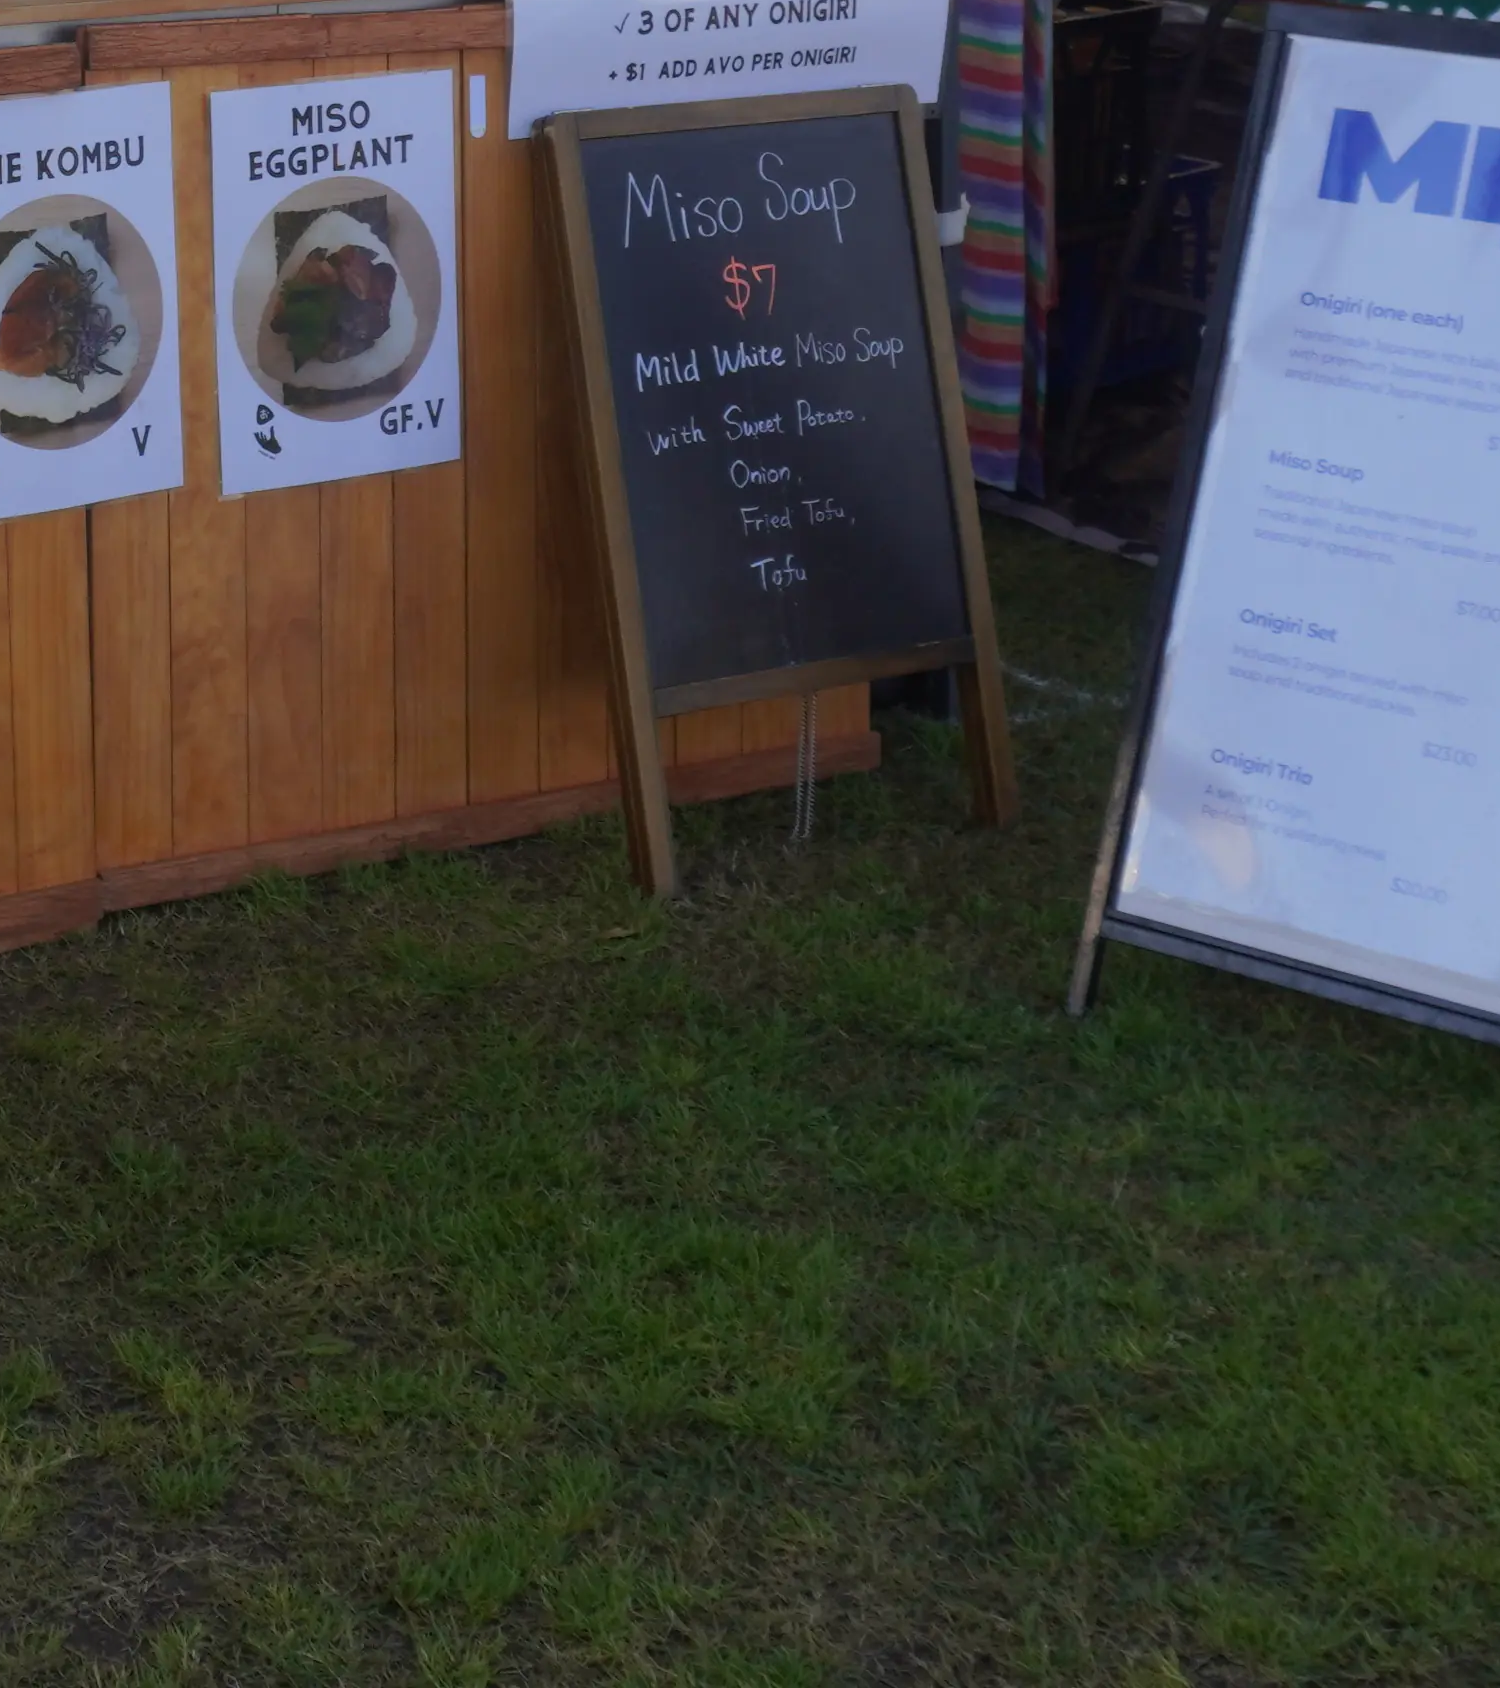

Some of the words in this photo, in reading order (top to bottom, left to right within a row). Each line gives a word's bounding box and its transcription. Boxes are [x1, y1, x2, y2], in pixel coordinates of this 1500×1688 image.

[638, 10, 653, 35] 3
[664, 6, 696, 33] OF
[706, 3, 760, 31] ANY
[625, 62, 646, 84] $1
[659, 58, 697, 81] ADD
[704, 54, 744, 77] AVO
[753, 50, 784, 73] PER
[789, 45, 857, 69] ONIGIRI
[291, 100, 370, 136] MISO
[35, 135, 145, 182] KOMBU
[248, 133, 415, 181] EGGPLANT
[624, 173, 745, 248] Miso
[759, 152, 857, 243] Soup
[723, 256, 777, 319] $7
[1301, 291, 1362, 315] Onigiri
[1412, 310, 1465, 335] each)
[636, 350, 701, 391] Mild
[713, 342, 786, 383] White
[796, 333, 847, 368] Miso
[855, 328, 904, 377] Soup
[132, 425, 152, 456] V
[648, 416, 706, 455] with
[722, 405, 785, 441] Sweet
[1269, 449, 1312, 471] Miso
[1316, 458, 1365, 483] Soup
[740, 506, 793, 536] Fried
[750, 554, 807, 591] Tofu
[1240, 608, 1304, 634] Onigiri
[1307, 622, 1338, 643] Set
[1211, 748, 1272, 776] Onigiri
[1277, 763, 1314, 785] Trio
